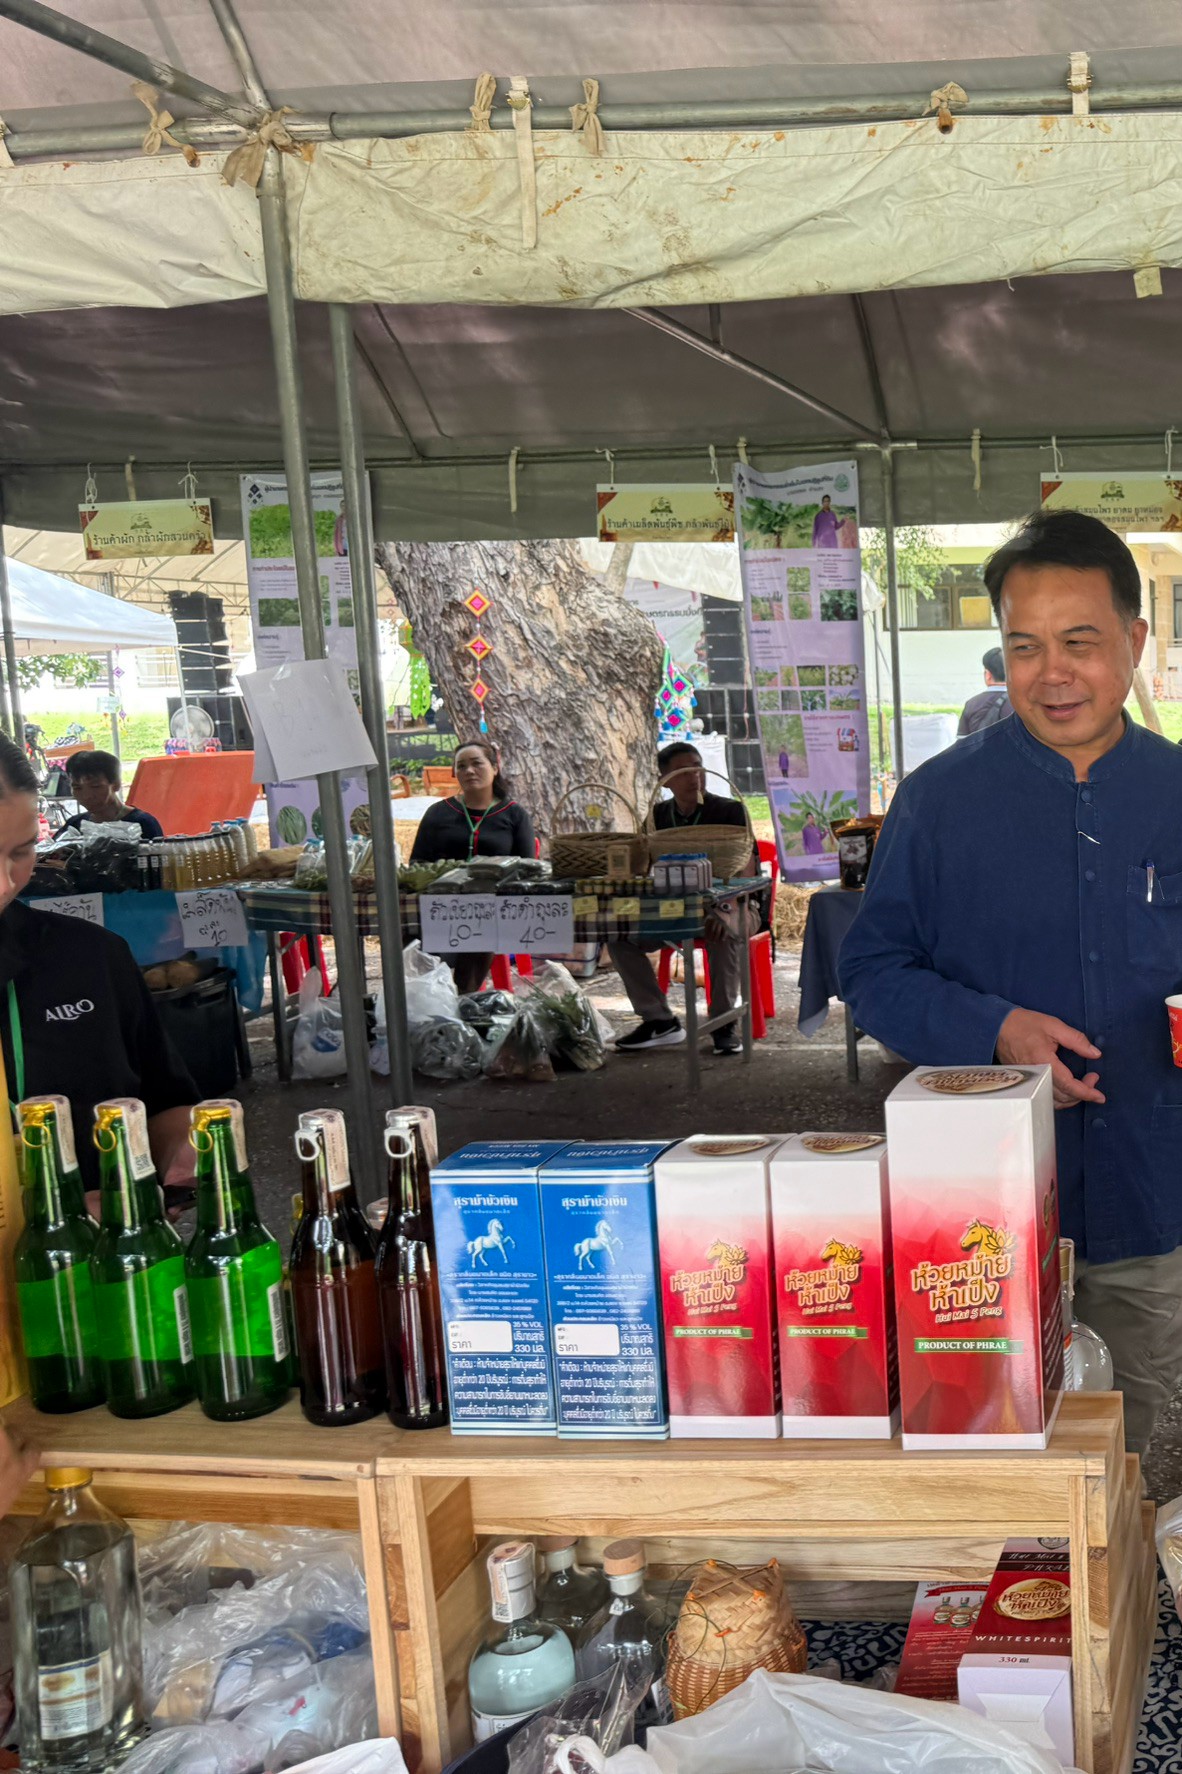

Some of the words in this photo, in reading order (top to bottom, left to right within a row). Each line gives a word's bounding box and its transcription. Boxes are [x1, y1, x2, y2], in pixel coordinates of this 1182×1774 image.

[911, 1252, 1012, 1292] ห้วยหม้าย
[670, 1263, 745, 1292] ห้วยหม้าย
[785, 1263, 860, 1292] ห้วยหม้าย
[935, 1313, 952, 1323] Hui
[952, 1310, 969, 1321] Mai
[980, 1306, 1003, 1317] Peng
[451, 1340, 472, 1349] ราคา
[514, 1344, 530, 1353] 330
[558, 1344, 578, 1352] ราคา
[918, 1341, 961, 1349] PRODUCT
[962, 1341, 975, 1349] OF
[977, 1341, 1007, 1349] PHRAE
[621, 1347, 638, 1356] 330
